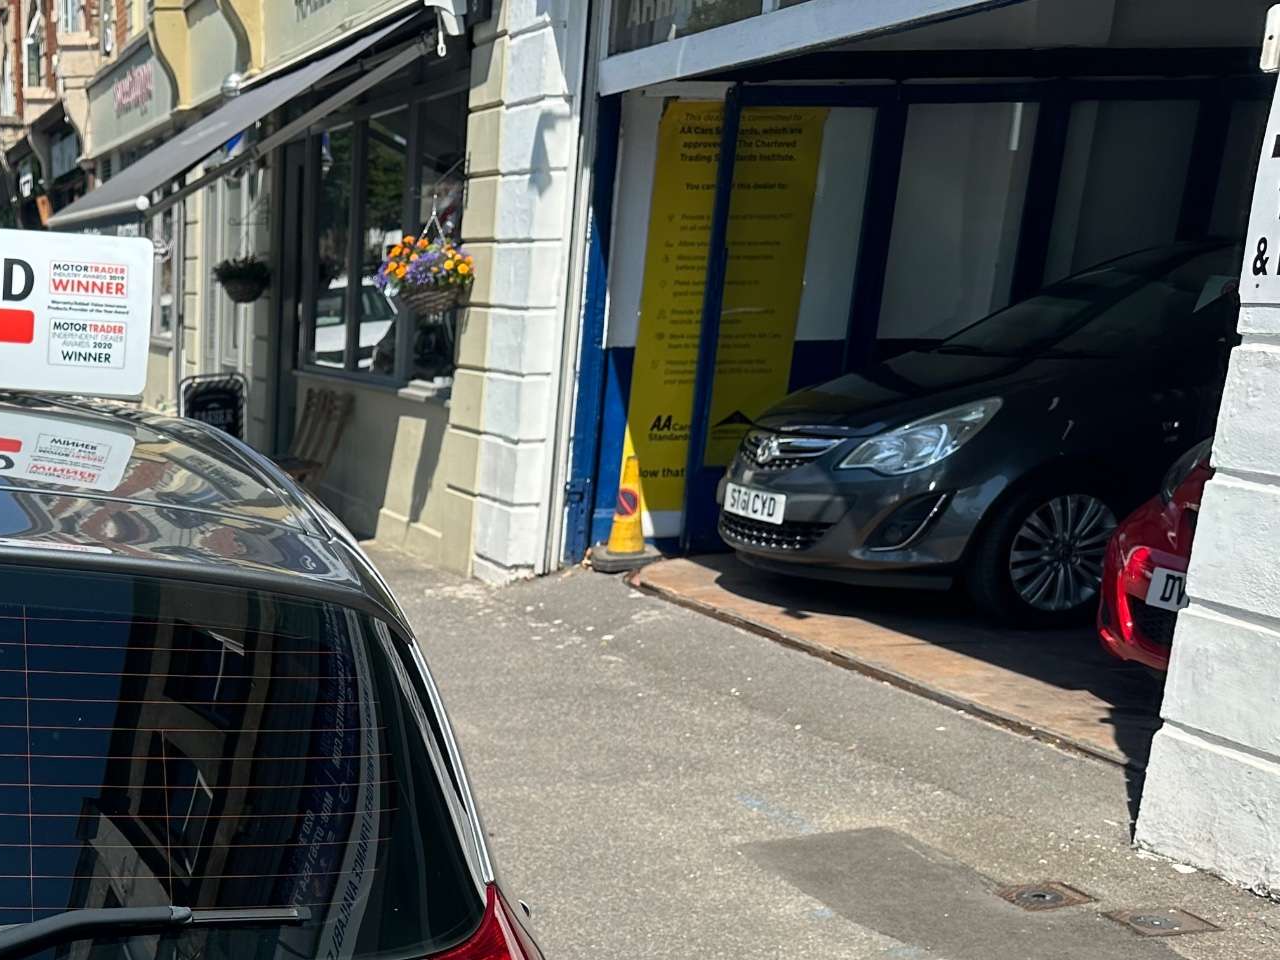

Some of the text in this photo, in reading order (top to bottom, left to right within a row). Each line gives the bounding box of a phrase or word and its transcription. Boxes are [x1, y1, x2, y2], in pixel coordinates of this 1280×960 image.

[755, 140, 797, 148] Chartered
[680, 153, 711, 163] Trading
[1252, 237, 1270, 276] &
[52, 278, 125, 296] WINNER
[52, 332, 124, 343] INDEPENDENT DEALER
[61, 339, 113, 350] AWARDS 2020
[61, 350, 112, 364] WINNER
[649, 414, 673, 431] AA
[662, 467, 684, 478] that
